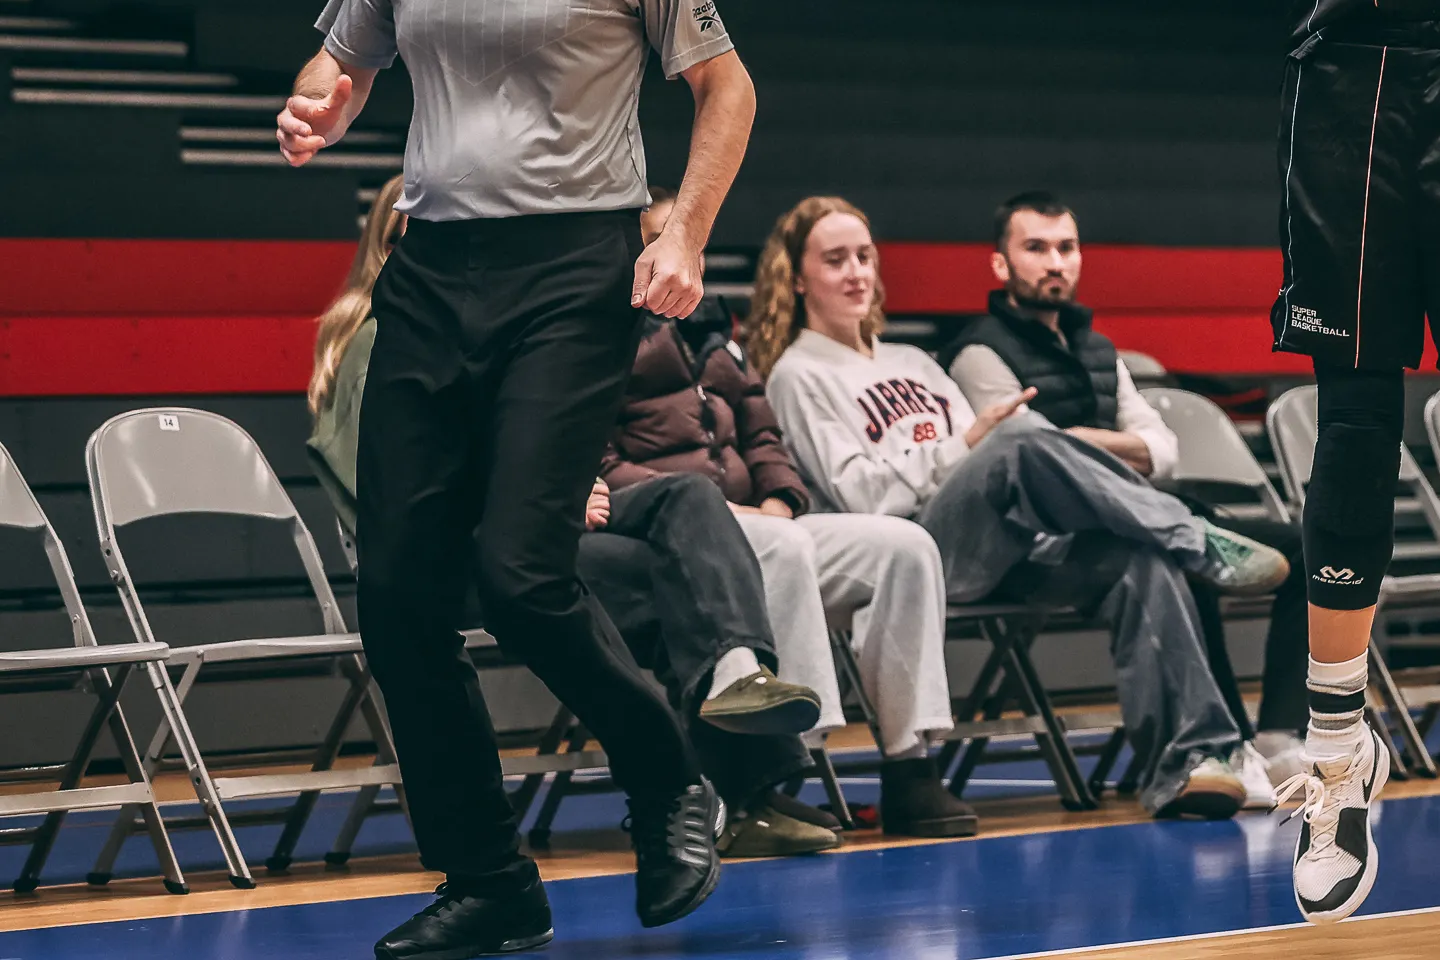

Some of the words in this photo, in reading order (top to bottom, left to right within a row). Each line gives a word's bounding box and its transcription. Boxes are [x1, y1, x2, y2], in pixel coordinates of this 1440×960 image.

[1291, 304, 1317, 318] SUPER
[1291, 312, 1323, 326] LEAGUE
[1291, 319, 1350, 337] BASKETBALL
